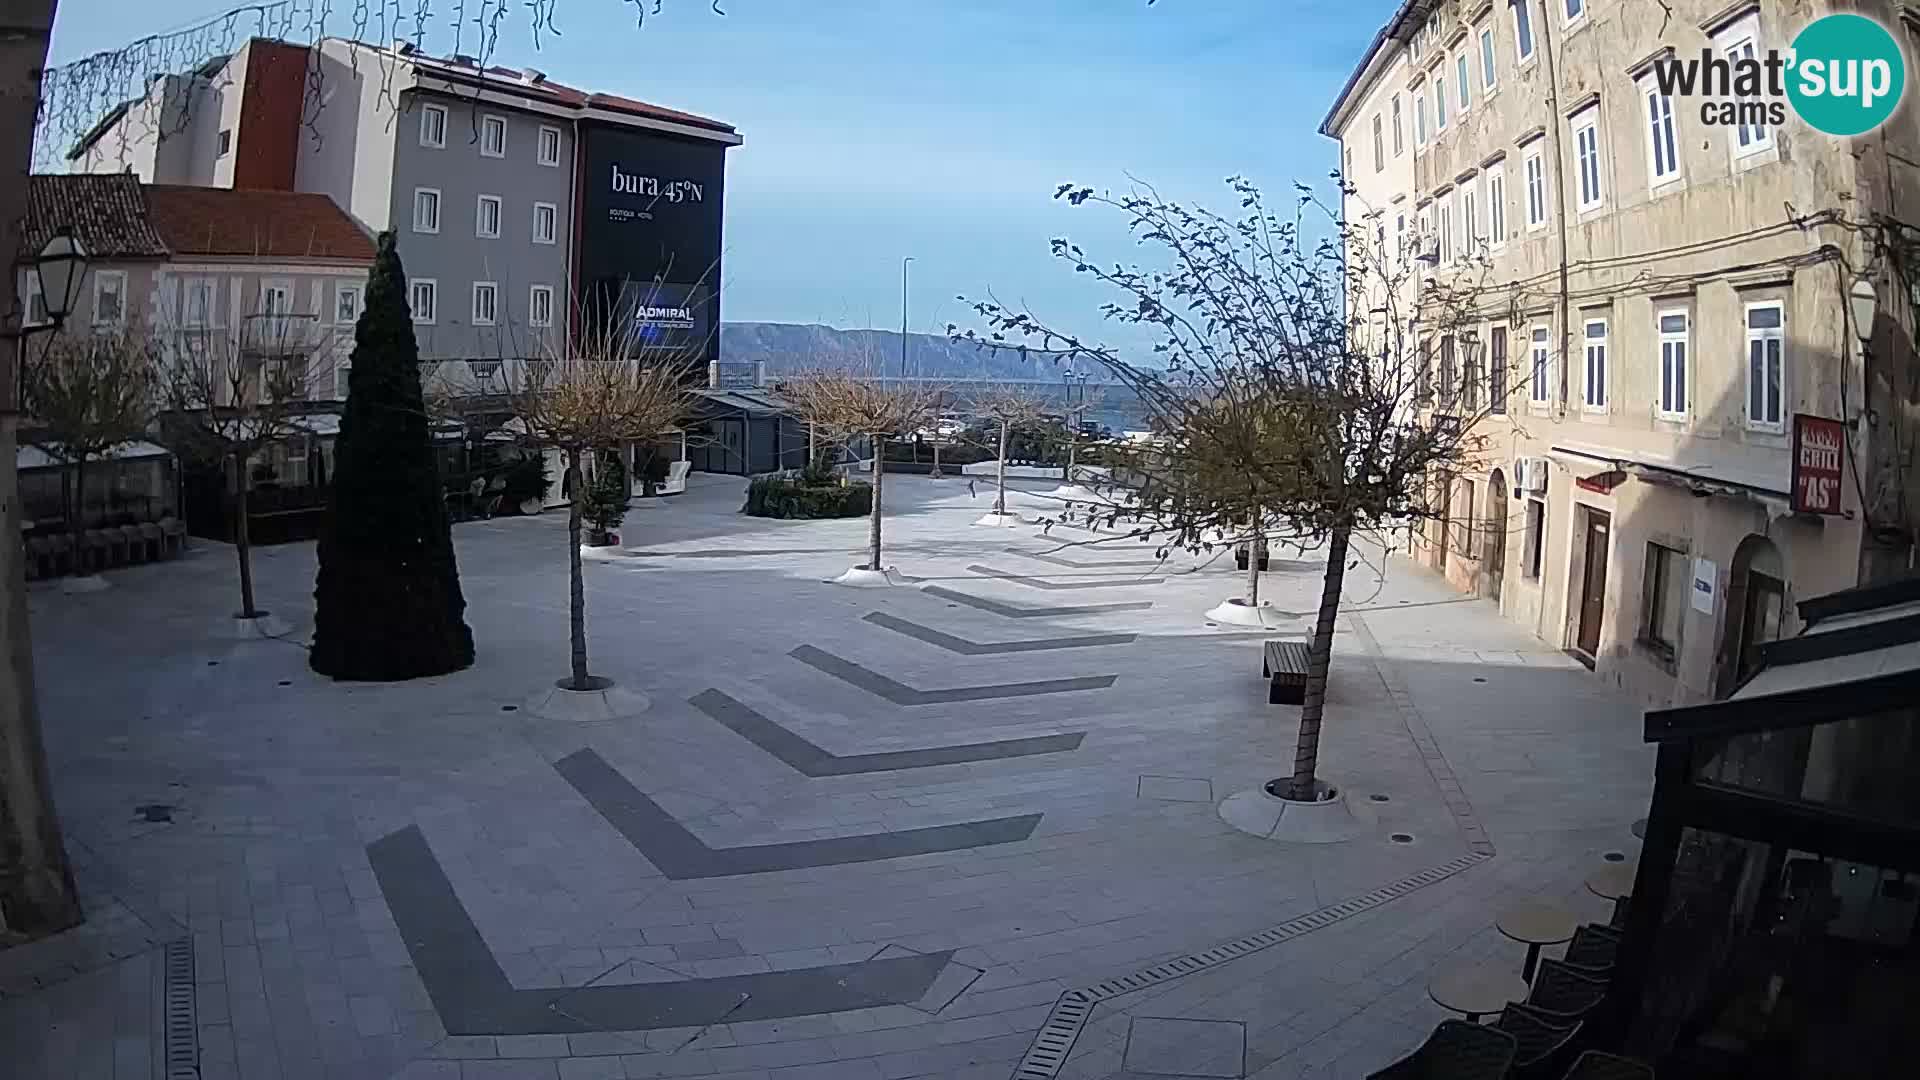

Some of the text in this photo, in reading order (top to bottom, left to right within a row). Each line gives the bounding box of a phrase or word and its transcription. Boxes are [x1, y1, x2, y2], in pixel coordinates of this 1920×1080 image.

[612, 165, 658, 197] bura
[636, 305, 694, 321] ADMIRAL
[1800, 447, 1840, 472] GRILL
[1799, 476, 1839, 509] "AS"
